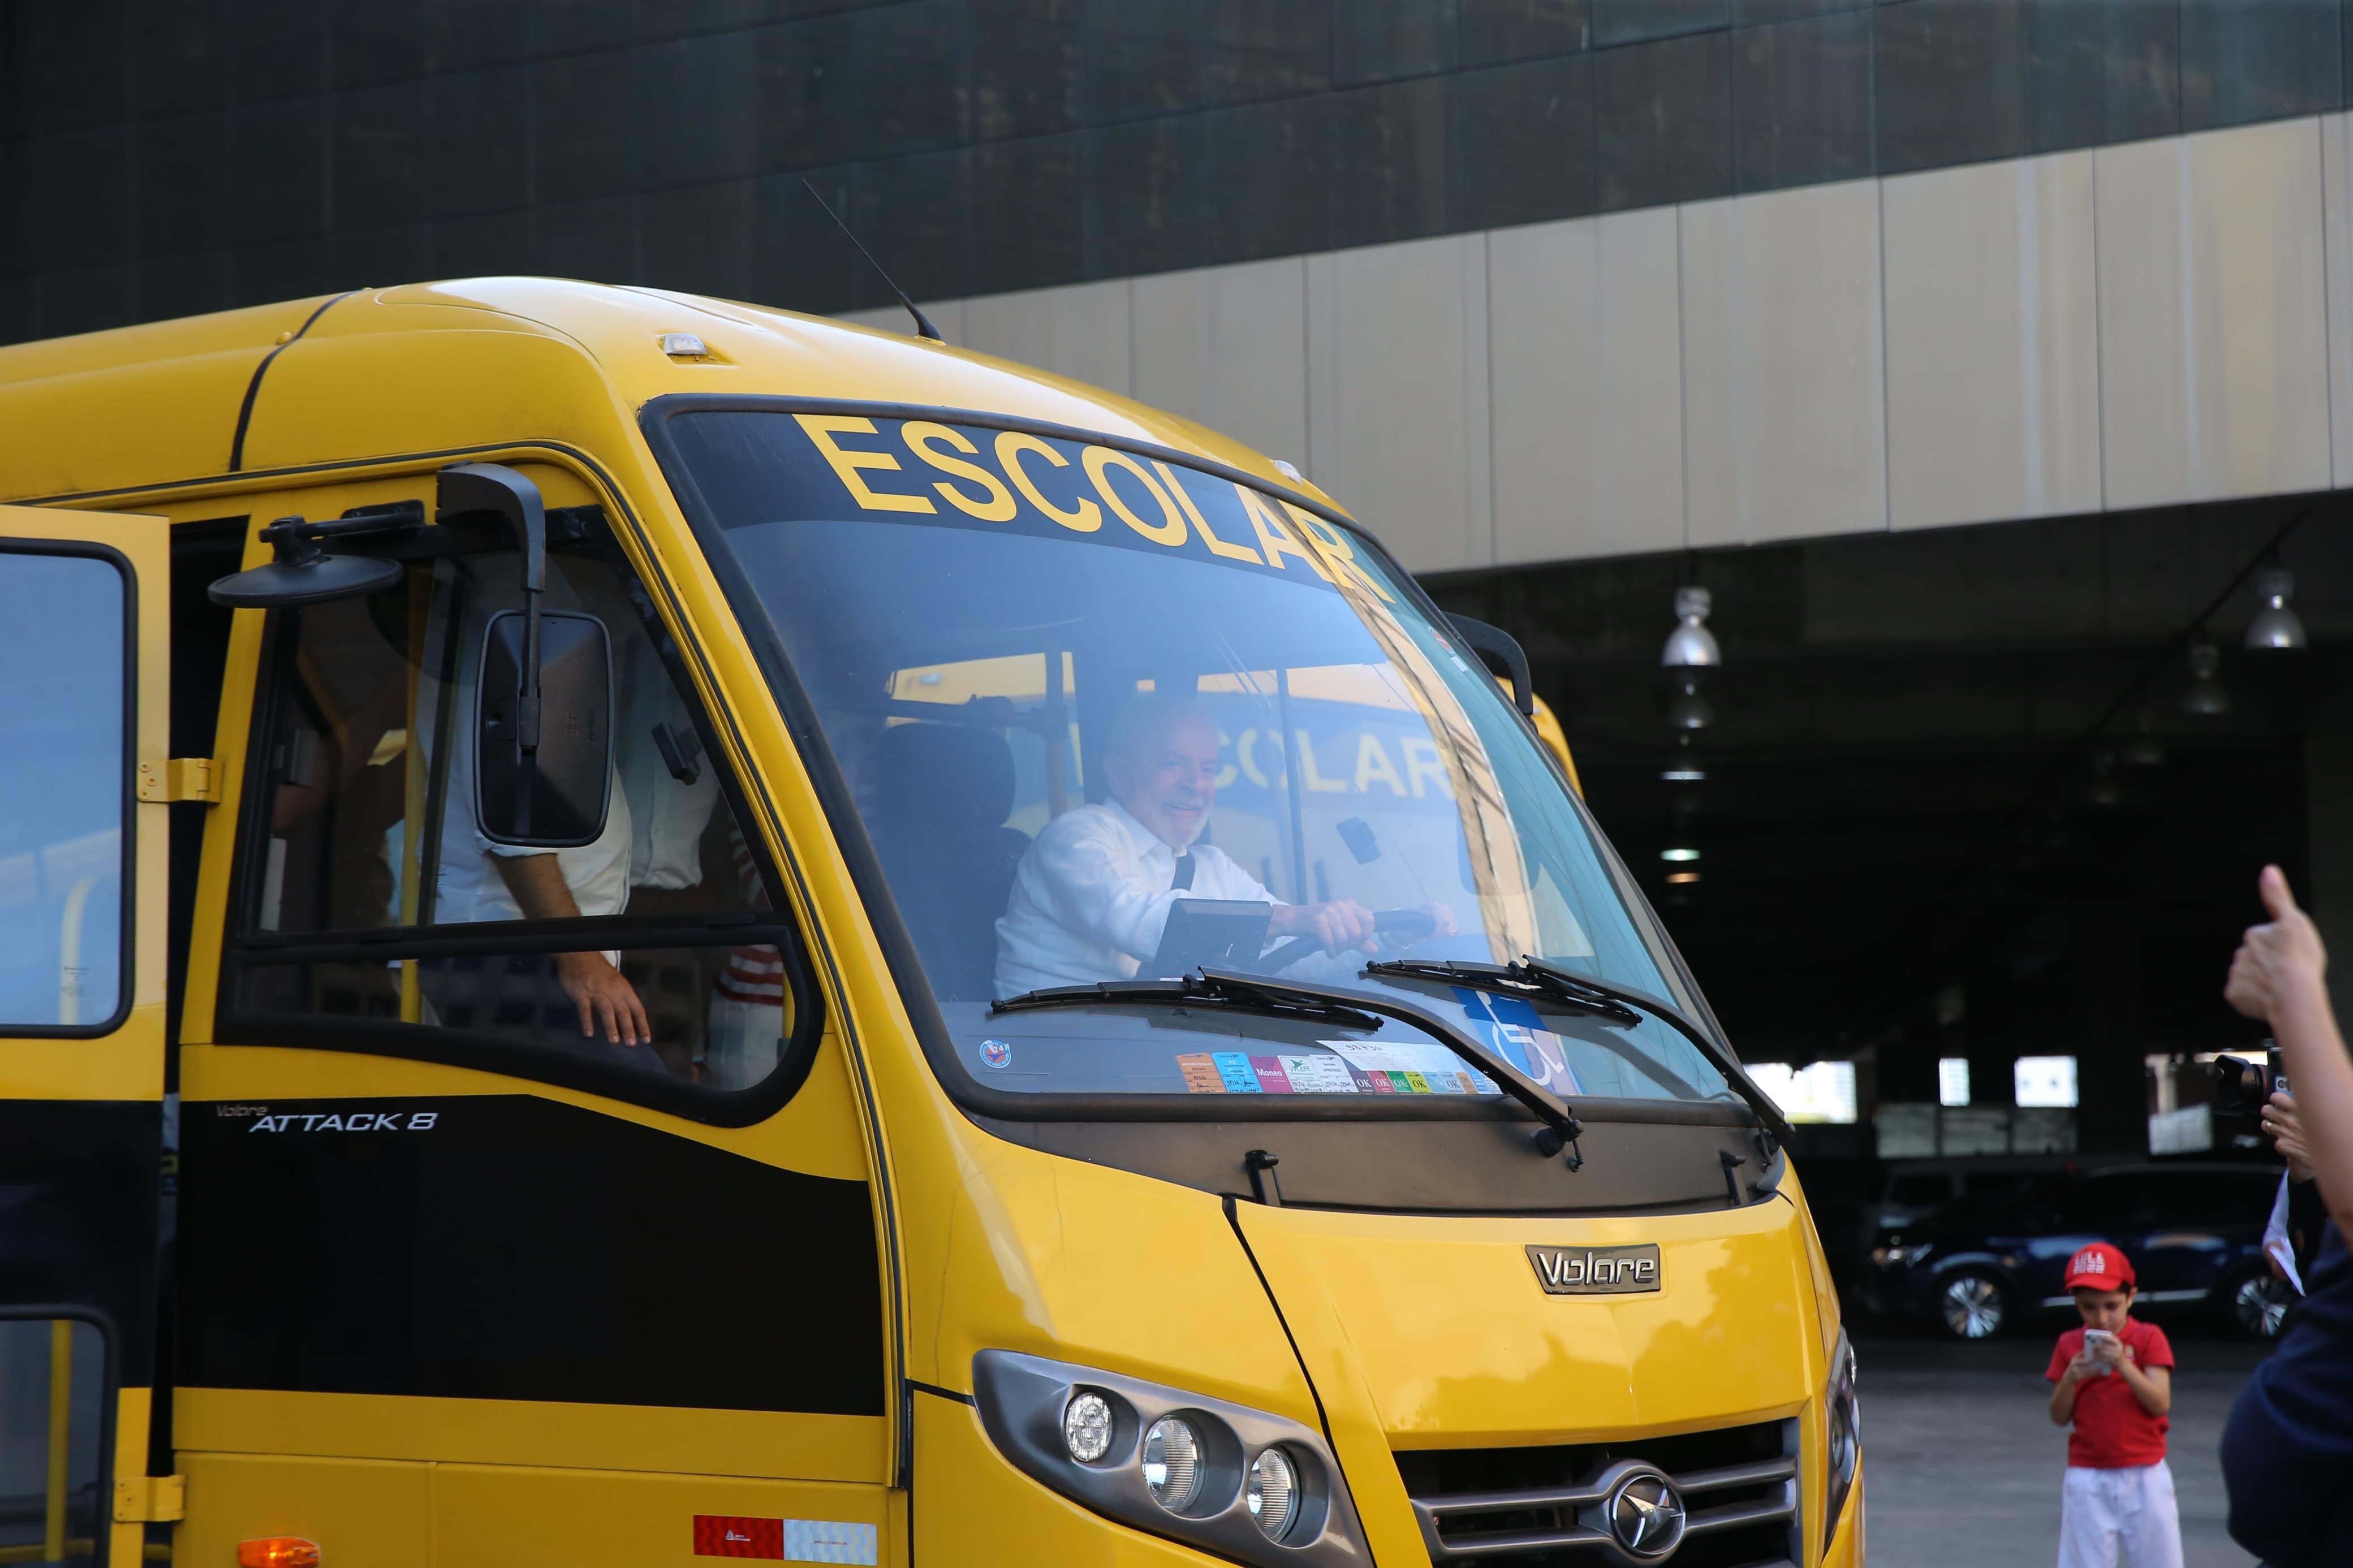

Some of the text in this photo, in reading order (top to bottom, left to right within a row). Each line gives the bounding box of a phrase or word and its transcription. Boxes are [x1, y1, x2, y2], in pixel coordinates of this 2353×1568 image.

[792, 414, 1397, 604] ESCOLAR
[1256, 1068, 1282, 1077] Moneo
[1357, 1079, 1372, 1087] OK
[1375, 1078, 1390, 1087] OK
[216, 1104, 269, 1116] Volare
[248, 1112, 438, 1132] ATTACK 8
[1537, 1251, 1654, 1286] Volare
